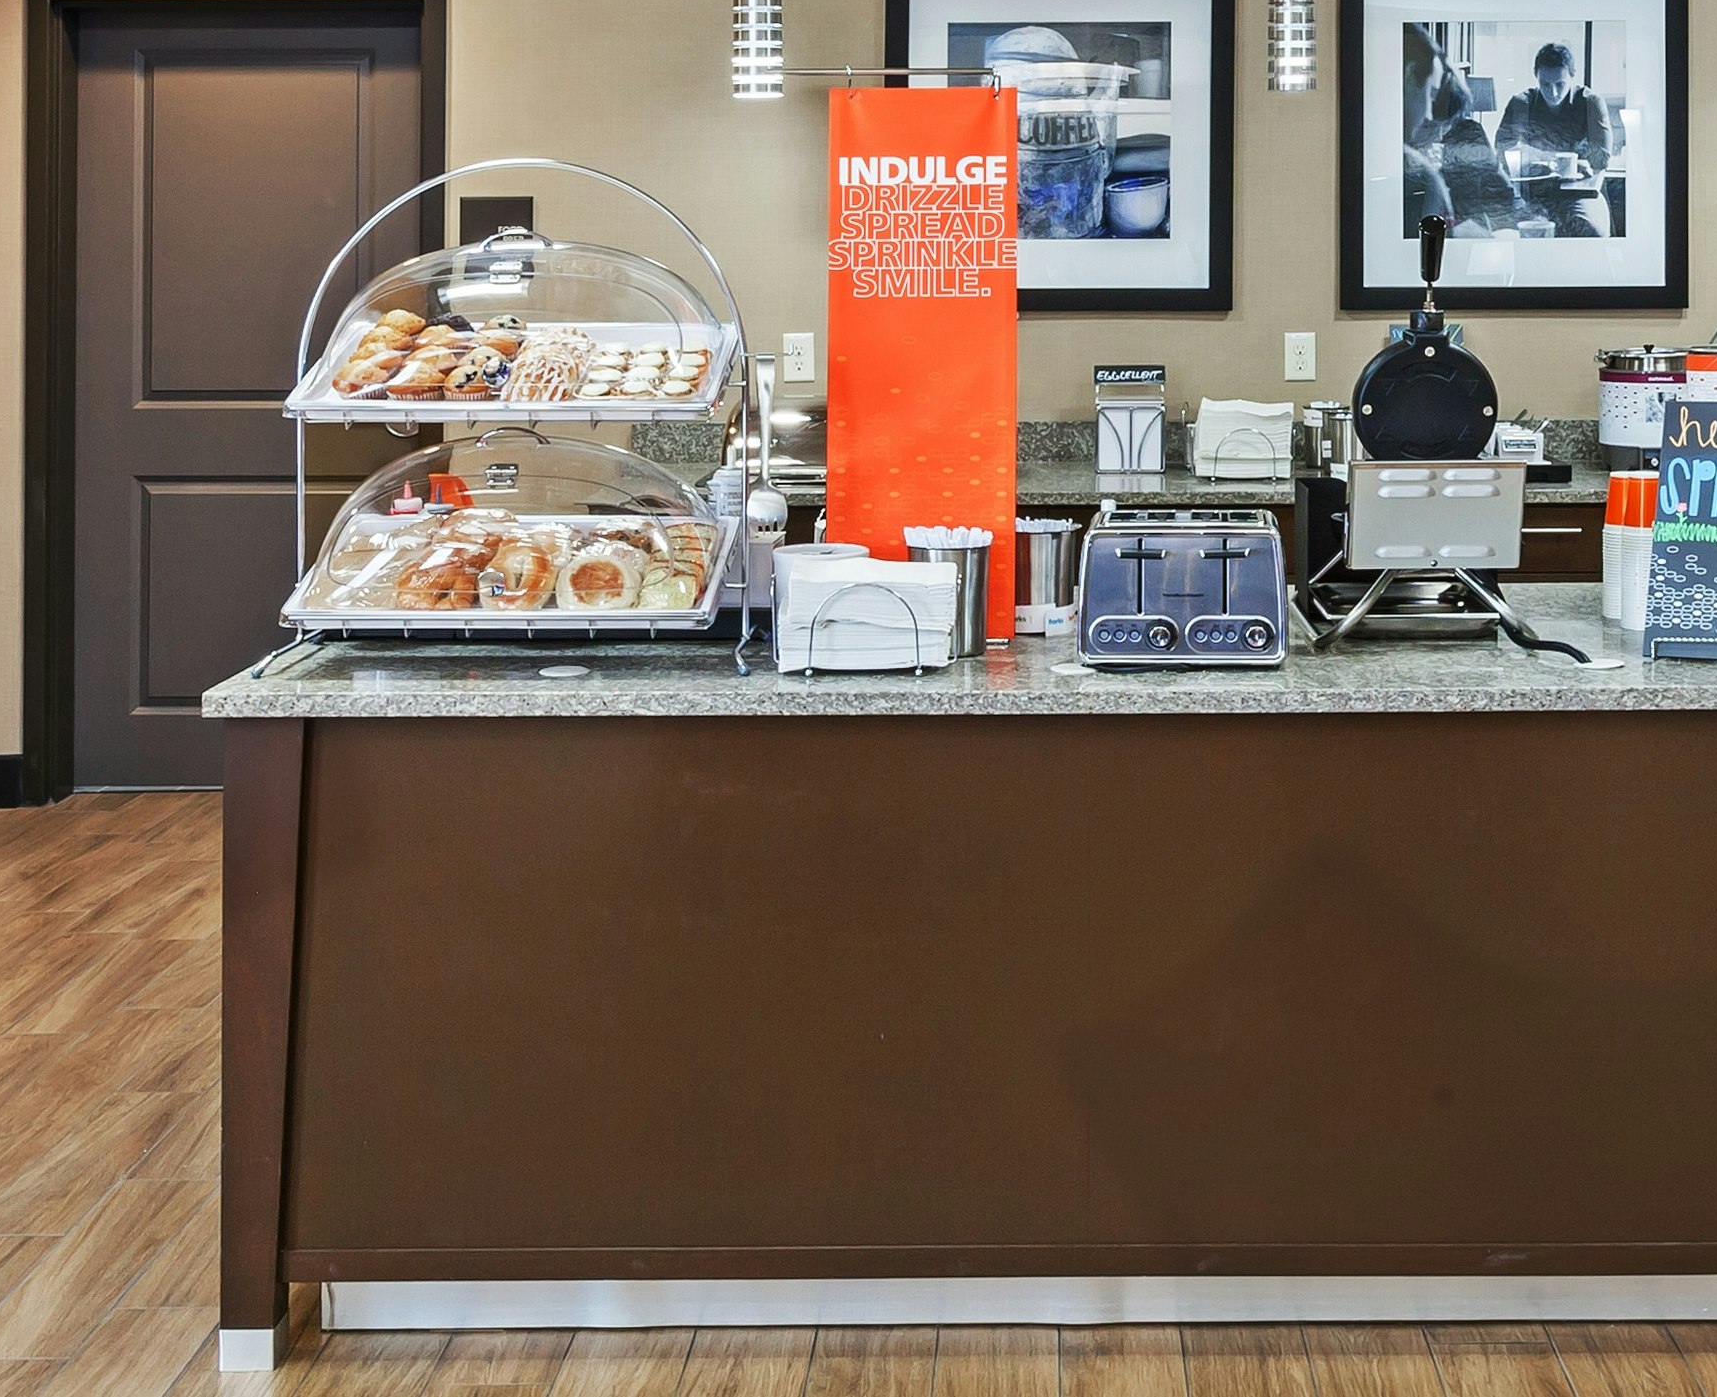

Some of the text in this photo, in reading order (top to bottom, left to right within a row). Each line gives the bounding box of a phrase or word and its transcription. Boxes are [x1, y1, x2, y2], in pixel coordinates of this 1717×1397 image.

[838, 155, 1008, 185] INDULGE
[842, 183, 1005, 212] DRIZZLE
[840, 211, 1005, 240] SPREAD
[828, 239, 1017, 270] SPRINKLE
[853, 267, 991, 297] SMILE.
[1097, 370, 1163, 381] EGGCELLENT
